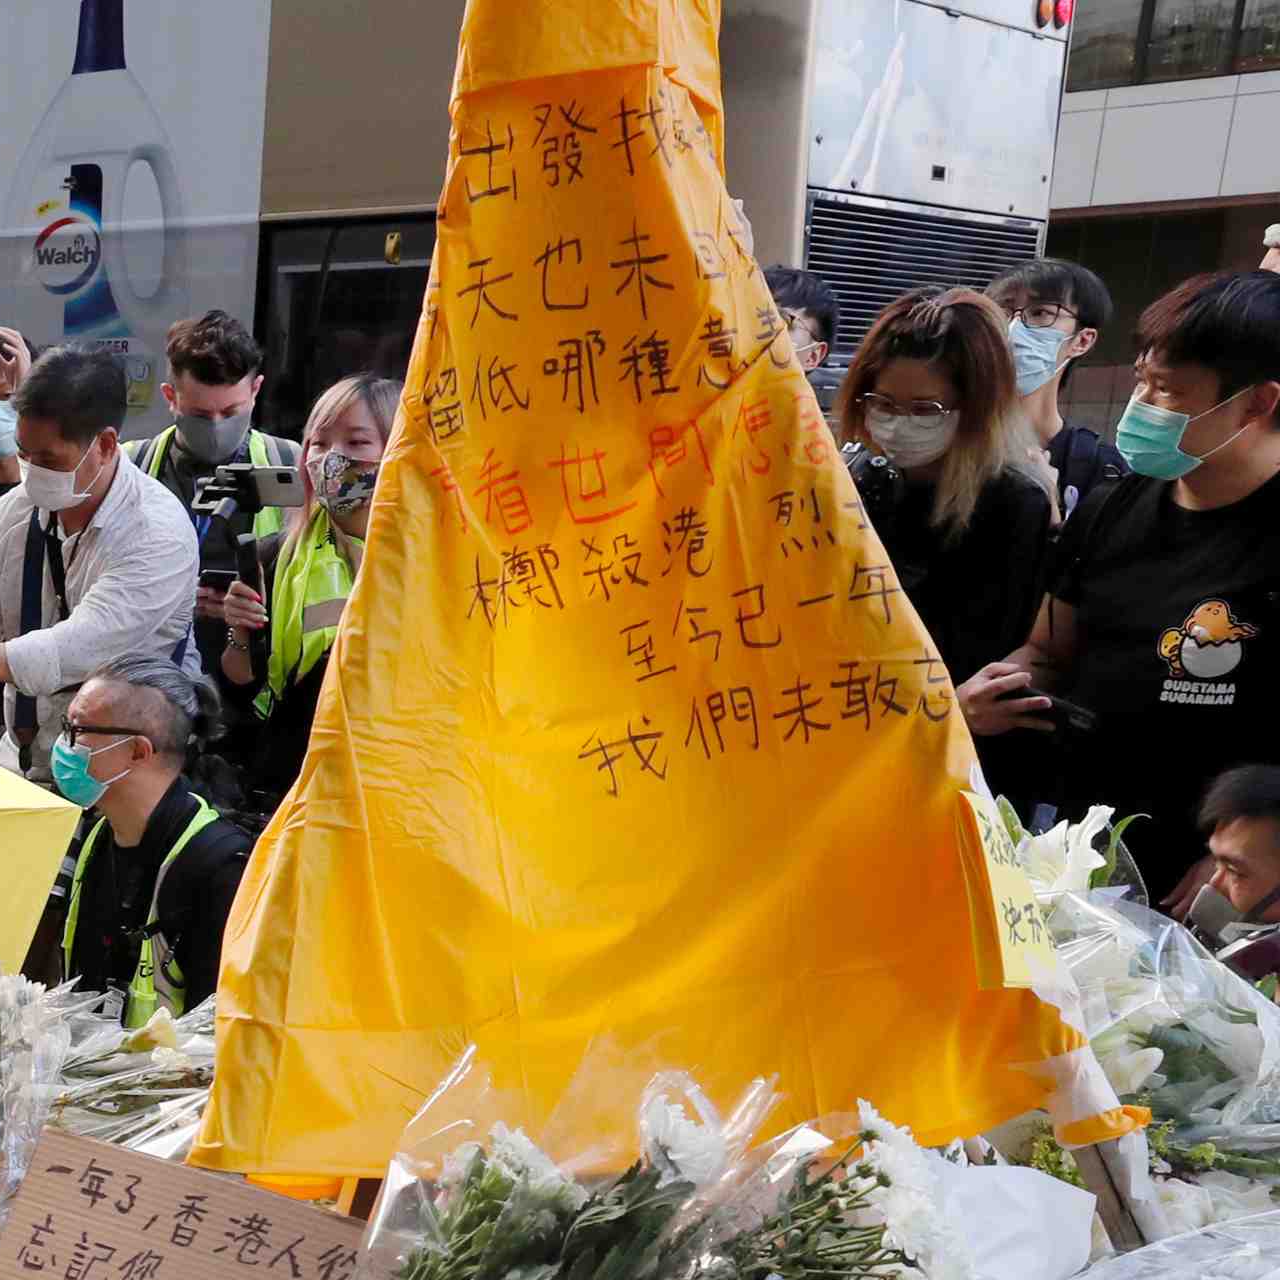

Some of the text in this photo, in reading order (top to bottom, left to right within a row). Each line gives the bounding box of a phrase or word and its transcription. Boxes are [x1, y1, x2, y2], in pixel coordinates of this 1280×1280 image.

[36, 247, 96, 266] Walch
[1163, 680, 1237, 695] GUDETAMA
[1159, 691, 1235, 705] SUGARMAN
